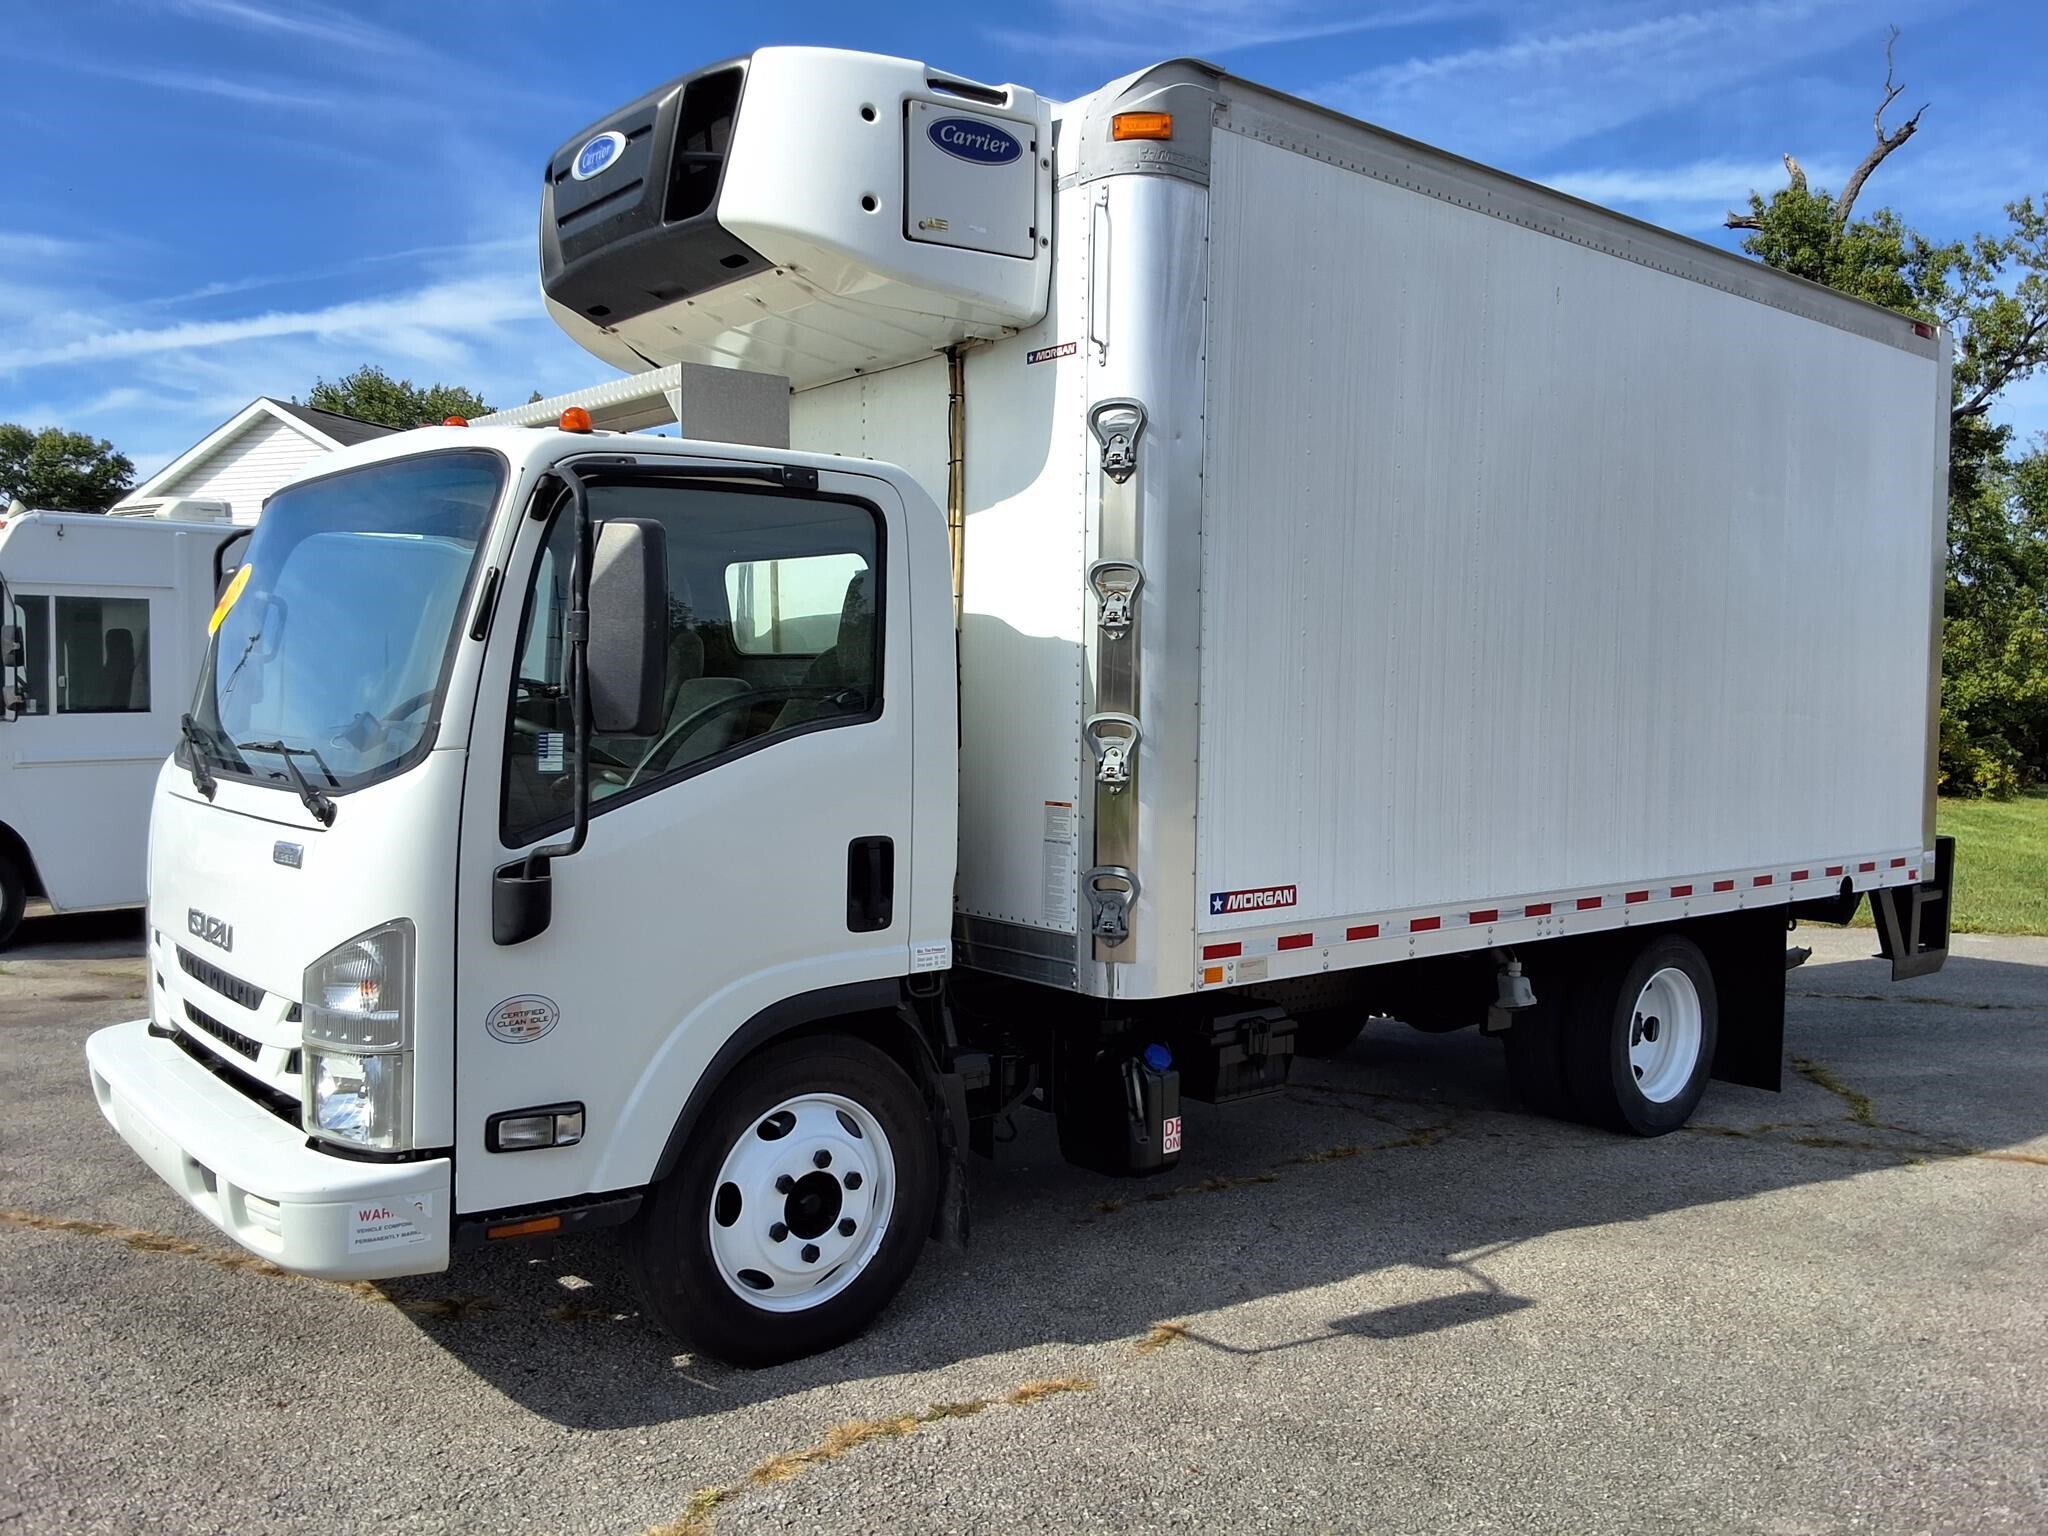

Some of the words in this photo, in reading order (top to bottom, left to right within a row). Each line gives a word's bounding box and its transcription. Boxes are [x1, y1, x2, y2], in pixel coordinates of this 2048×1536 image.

[940, 125, 1011, 153] Carrier
[1035, 344, 1076, 361] MORGAN
[1226, 889, 1294, 911] MORGAN
[188, 907, 233, 953] ISUZU
[496, 1019, 527, 1028] CLEAN
[530, 1015, 550, 1024] IDLE
[501, 1008, 546, 1020] CERTIFIED
[401, 1230, 422, 1238] MARK
